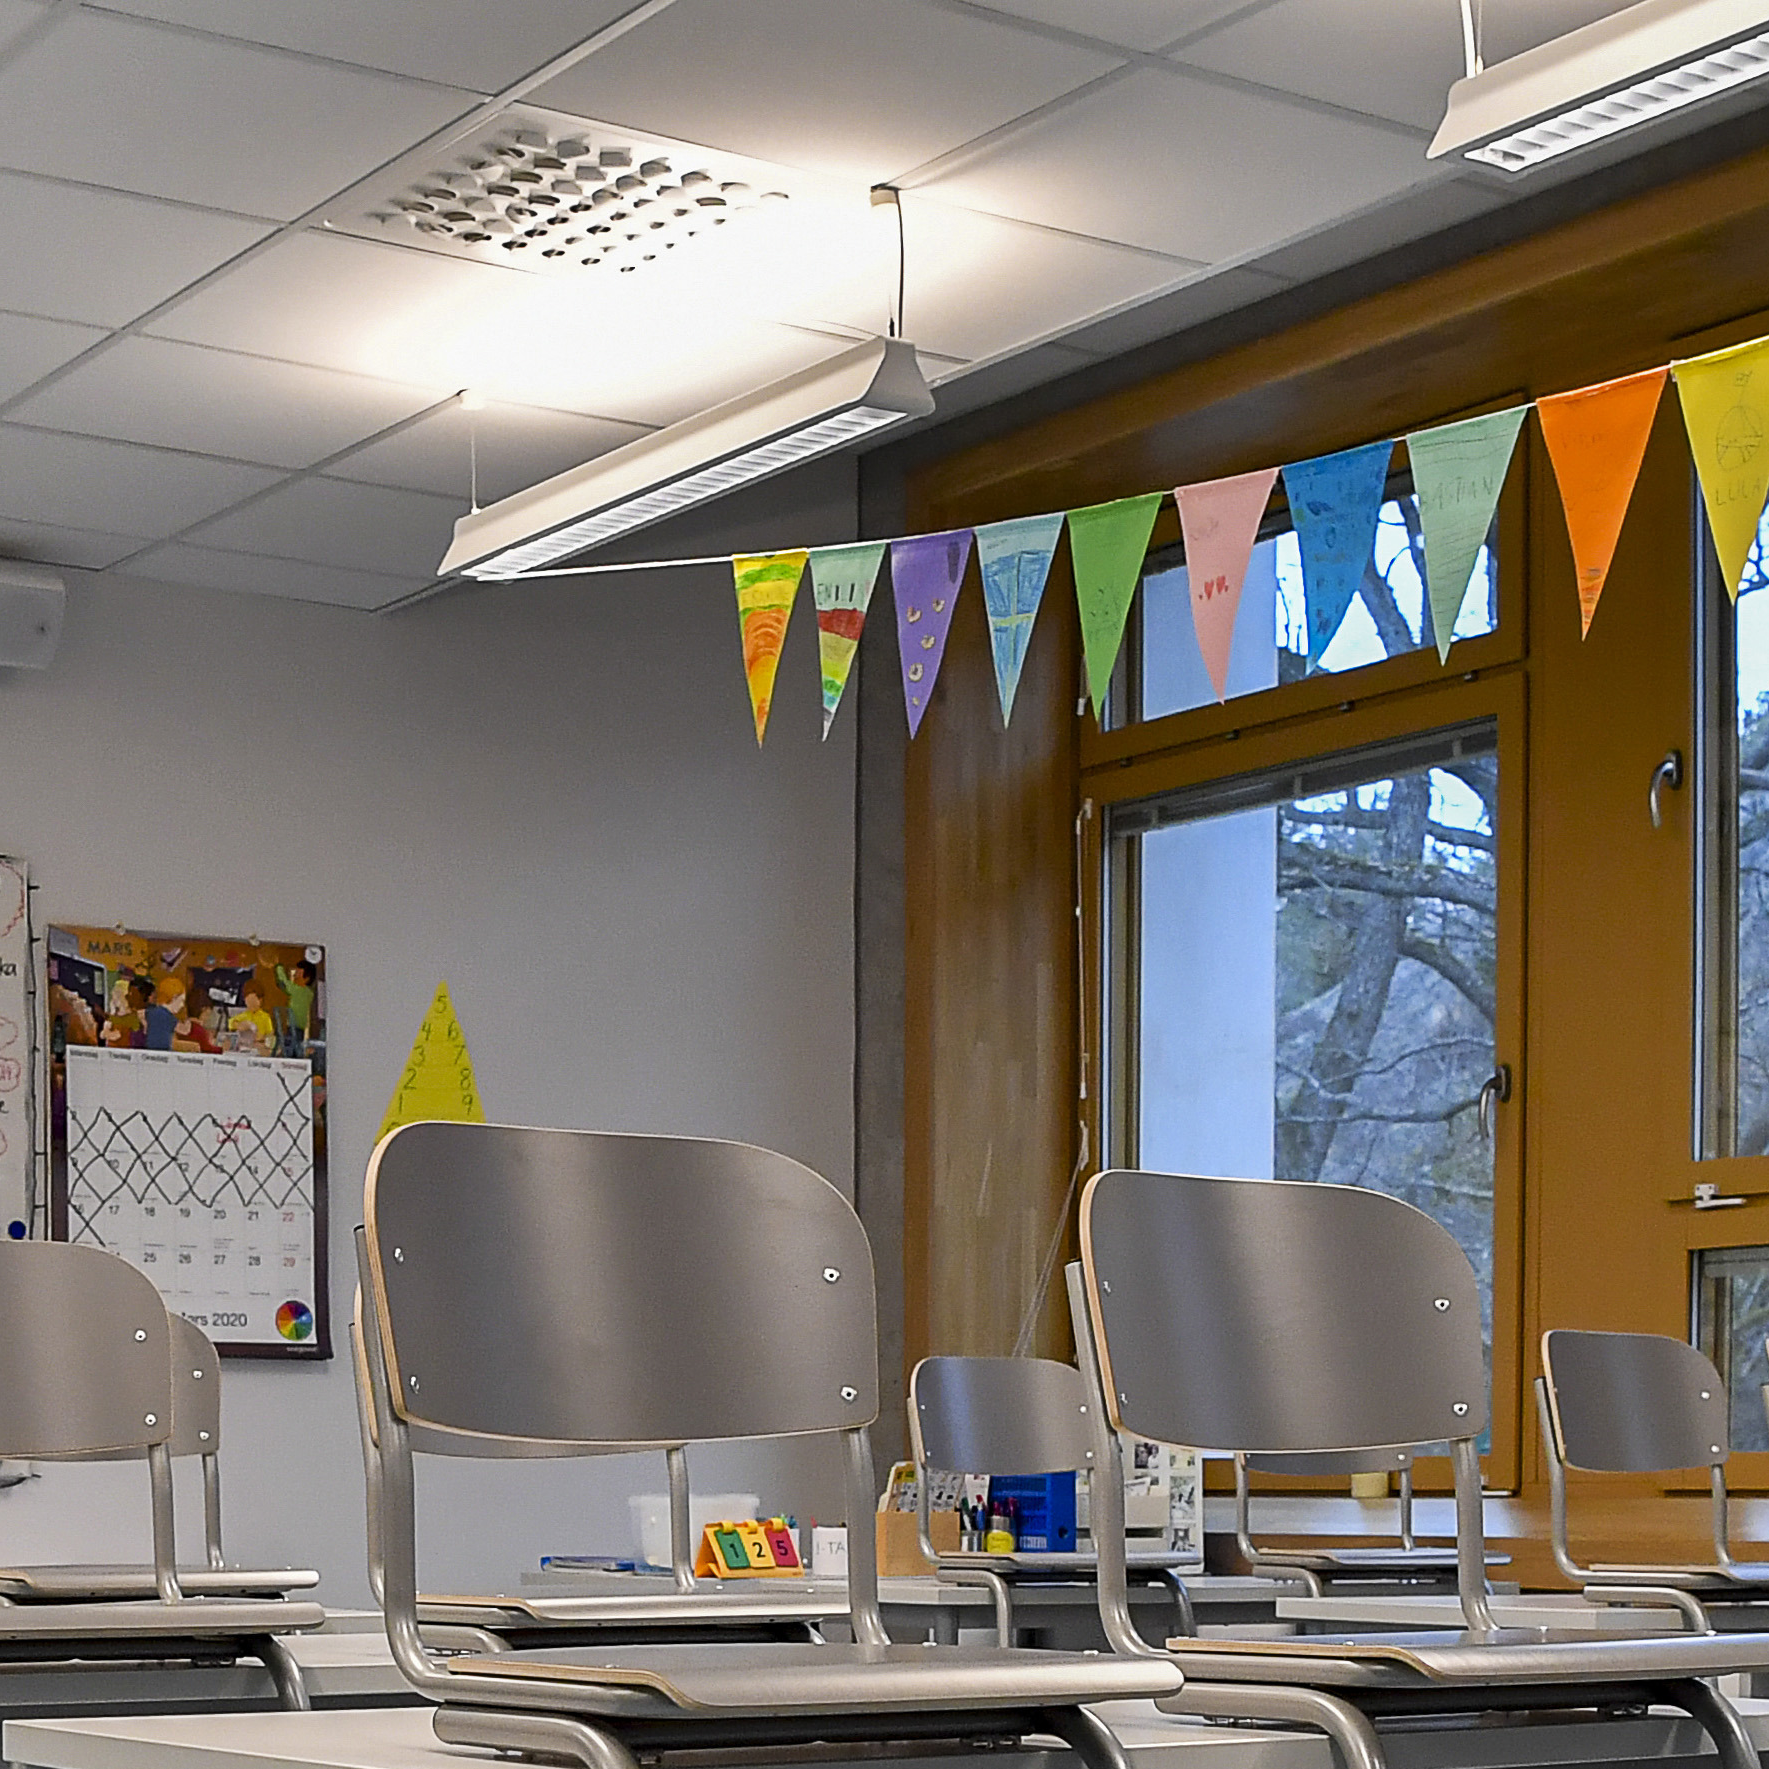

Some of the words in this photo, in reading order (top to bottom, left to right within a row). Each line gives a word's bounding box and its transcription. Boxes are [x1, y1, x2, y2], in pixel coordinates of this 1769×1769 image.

[87, 940, 133, 956] MARS
[434, 995, 447, 1013] 5
[422, 1021, 431, 1041] 4
[447, 1020, 459, 1041] 6
[413, 1044, 426, 1067] 3
[454, 1044, 466, 1065] 7
[403, 1068, 418, 1090] 2
[460, 1067, 471, 1090] 8
[398, 1092, 403, 1114] 1
[461, 1093, 473, 1115] 9
[108, 1205, 120, 1215] 17
[144, 1207, 156, 1217] 18
[179, 1208, 191, 1219] 19
[213, 1209, 227, 1220] 20
[247, 1210, 260, 1221] 21
[282, 1212, 295, 1223] 22
[143, 1252, 157, 1263] 25
[178, 1253, 192, 1264] 26
[213, 1255, 226, 1265] 27
[248, 1256, 261, 1267] 28
[283, 1257, 296, 1268] 29
[212, 1312, 248, 1328] 2020
[729, 1543, 739, 1559] 1
[752, 1542, 766, 1558] 2
[775, 1540, 788, 1556] 5
